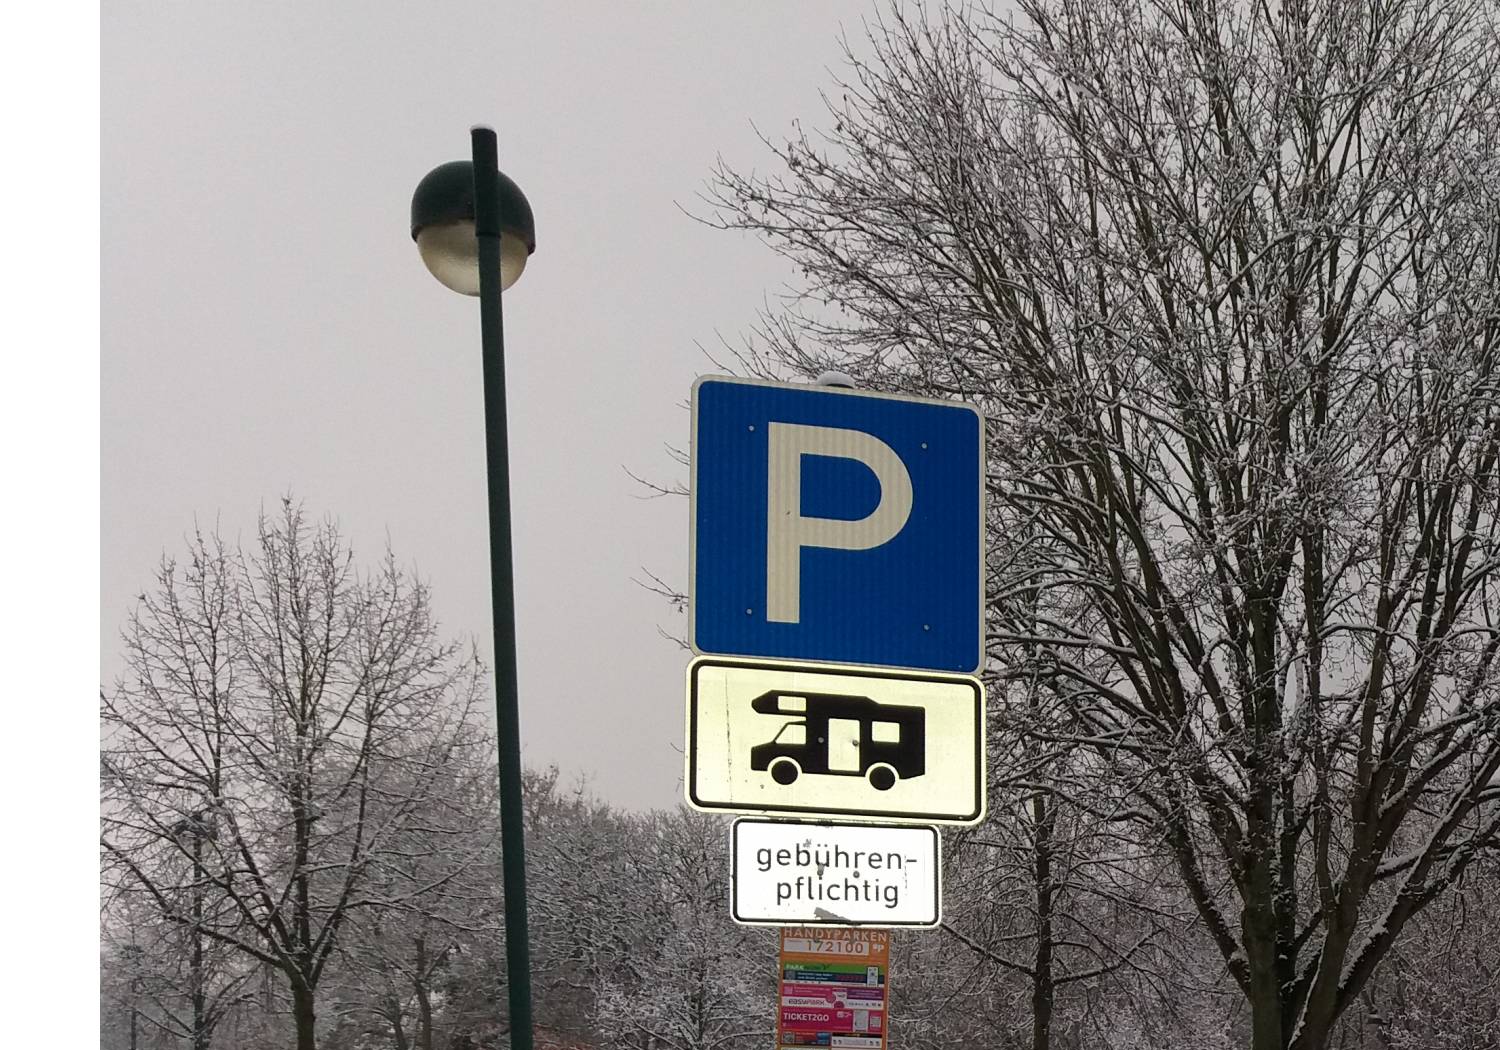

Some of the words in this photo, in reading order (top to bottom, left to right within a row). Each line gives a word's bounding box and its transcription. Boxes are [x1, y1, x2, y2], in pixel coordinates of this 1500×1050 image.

[767, 421, 914, 624] P
[757, 843, 917, 872] gebühren-
[777, 876, 898, 909] pflichtig
[784, 927, 887, 942] HANDYPARKEN
[807, 940, 864, 954] 172100
[783, 1012, 830, 1022] TICKET2GO
